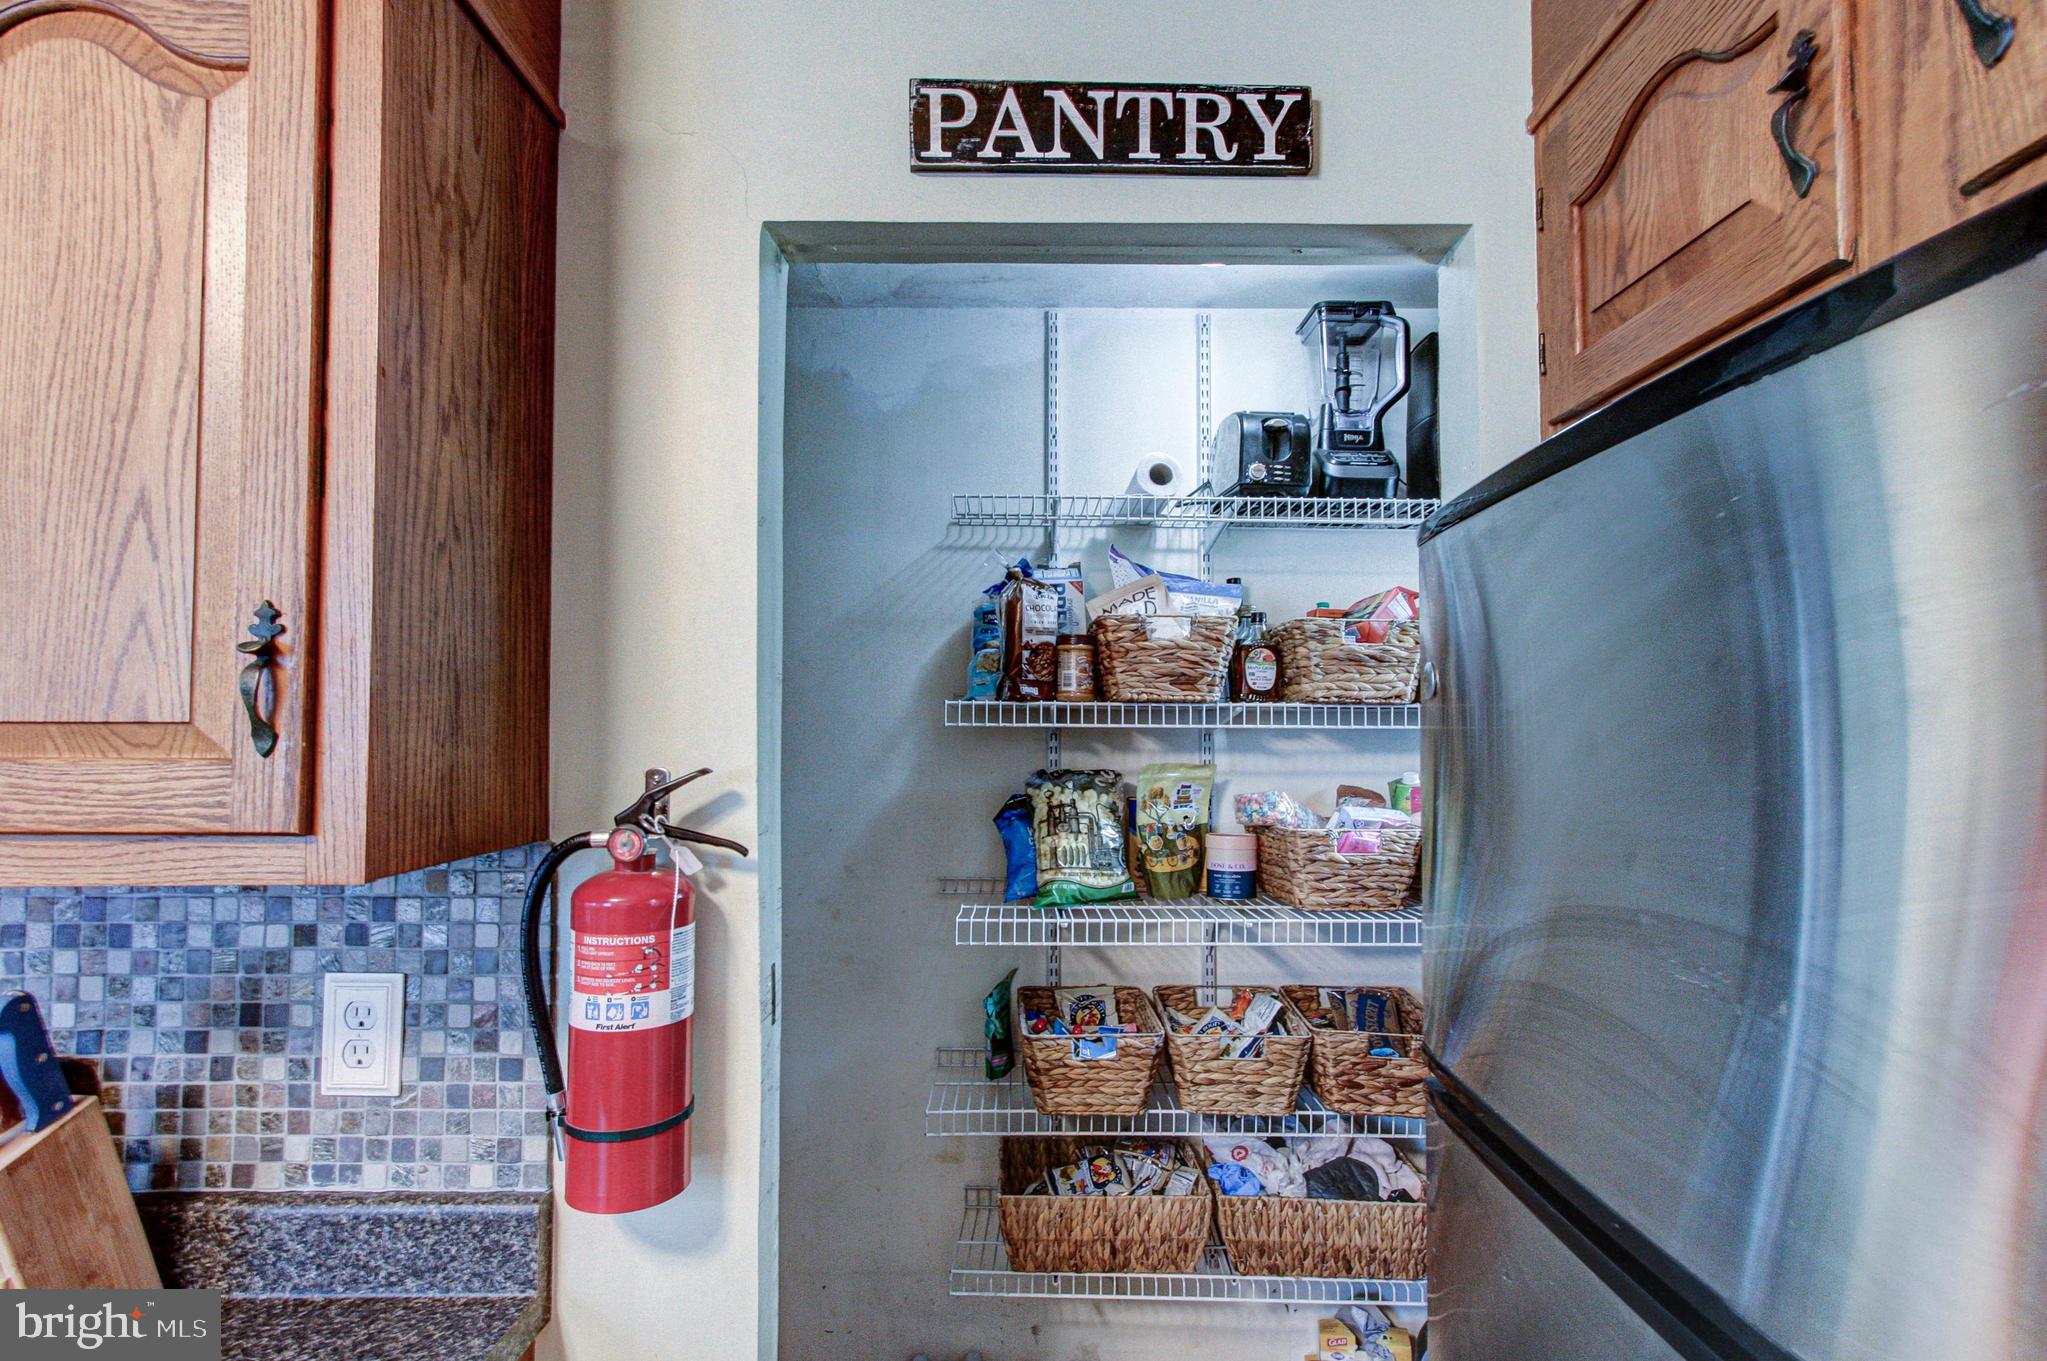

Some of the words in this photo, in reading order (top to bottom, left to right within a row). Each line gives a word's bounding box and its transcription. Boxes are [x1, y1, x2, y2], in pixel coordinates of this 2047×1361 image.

[919, 87, 1302, 161] PANTRY
[1102, 587, 1157, 614] MADE
[583, 935, 655, 946] INSTRUCTIONS
[595, 1023, 613, 1031] First
[1328, 1338, 1347, 1347] GLAD
